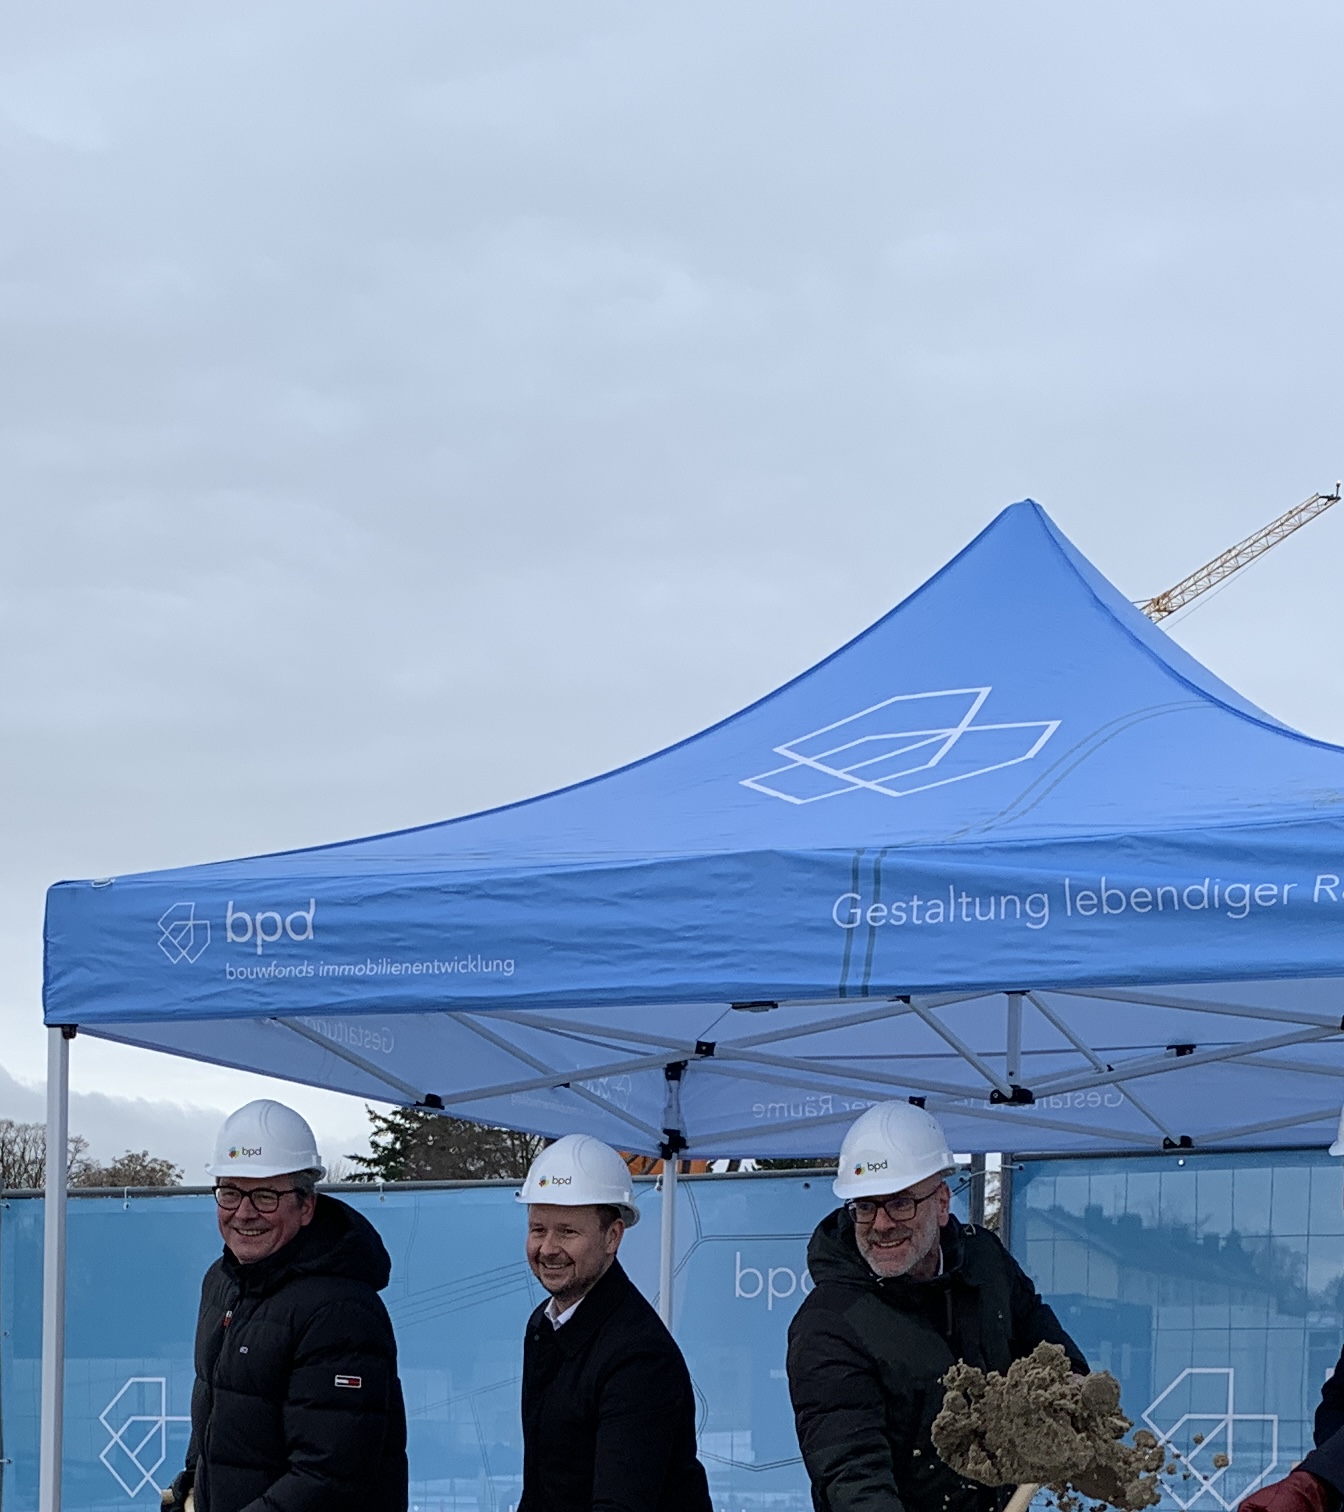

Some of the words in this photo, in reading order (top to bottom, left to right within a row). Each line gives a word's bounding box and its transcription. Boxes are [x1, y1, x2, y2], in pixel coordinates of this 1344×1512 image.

[832, 885, 1050, 930] Gestaltung
[1064, 876, 1298, 920] lebendiger
[225, 898, 316, 956] bpd
[225, 960, 315, 981] bouwfonds
[318, 954, 516, 979] immobilienentwicklung
[242, 1147, 261, 1157] bpd
[867, 1160, 887, 1172] bpd
[552, 1176, 572, 1187] bpd
